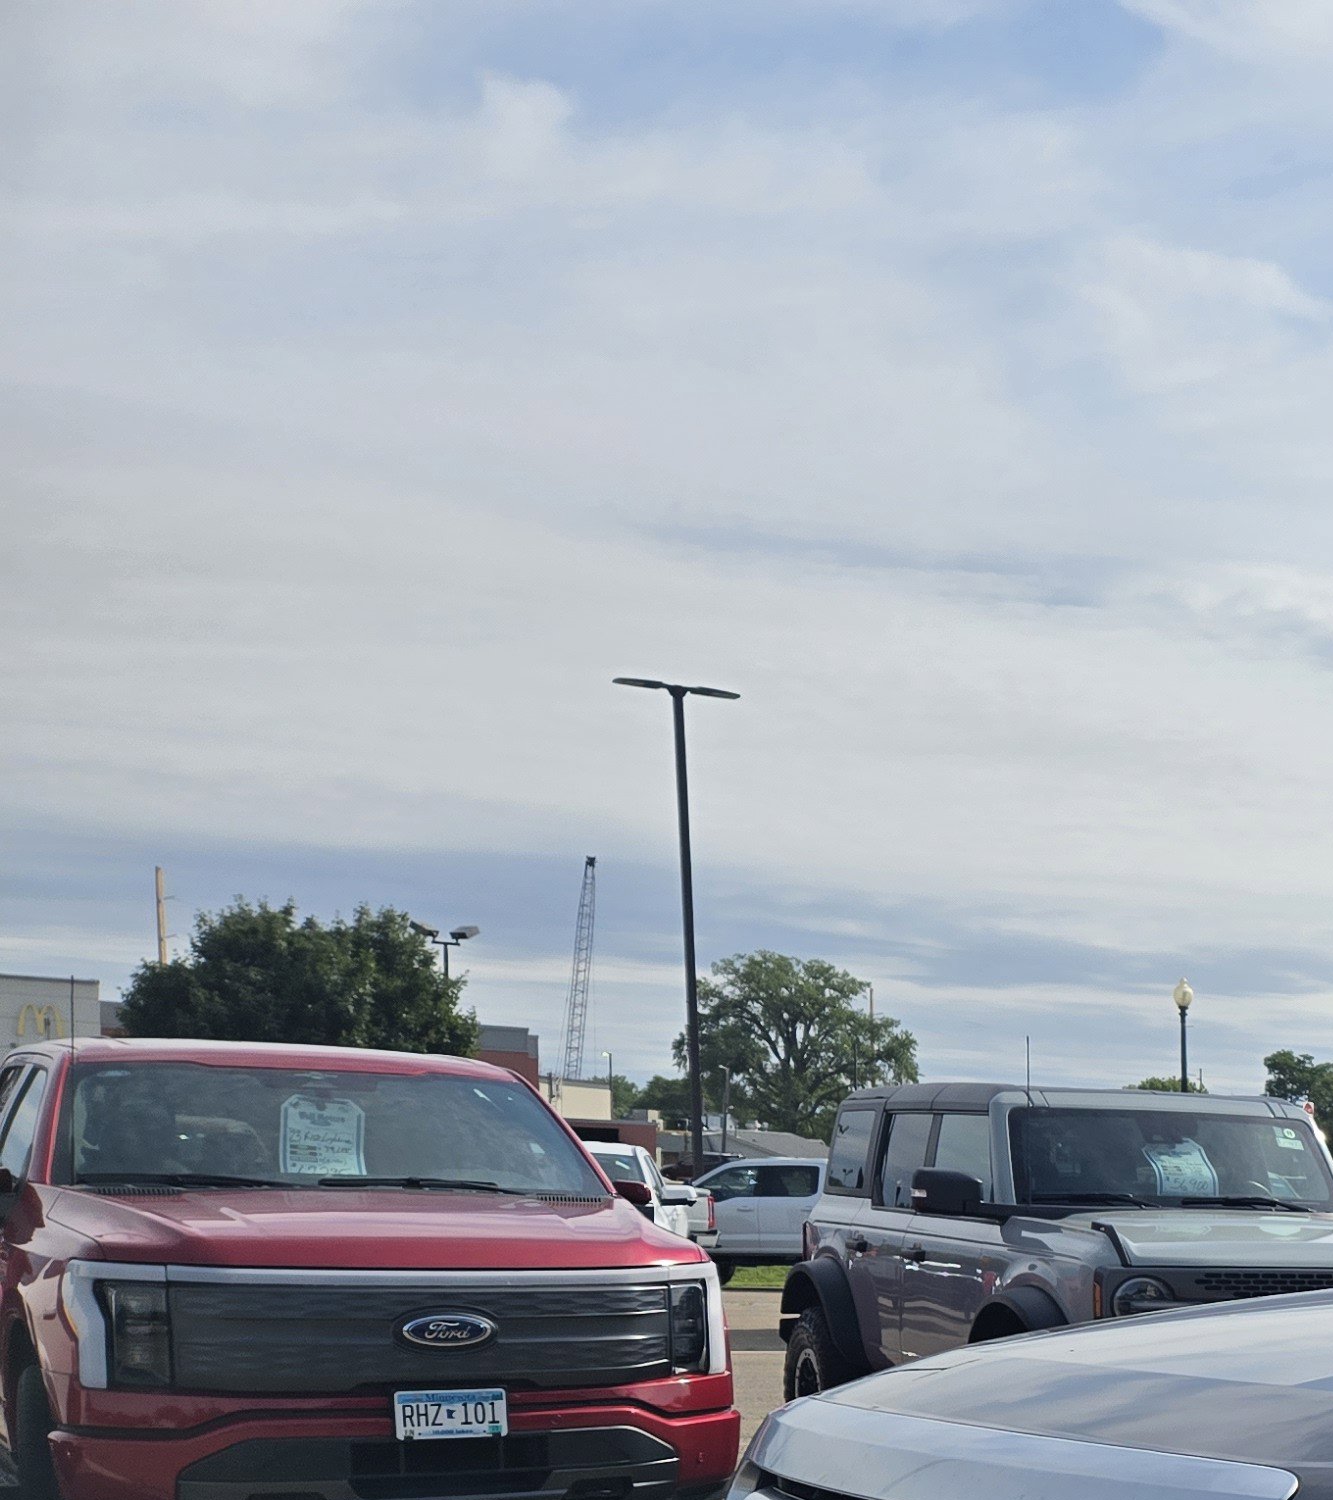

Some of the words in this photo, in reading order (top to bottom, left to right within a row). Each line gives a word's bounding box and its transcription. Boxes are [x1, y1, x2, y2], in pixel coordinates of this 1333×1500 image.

[424, 1321, 471, 1339] Ford
[402, 1403, 444, 1428] RHZ
[460, 1402, 500, 1426] 101
